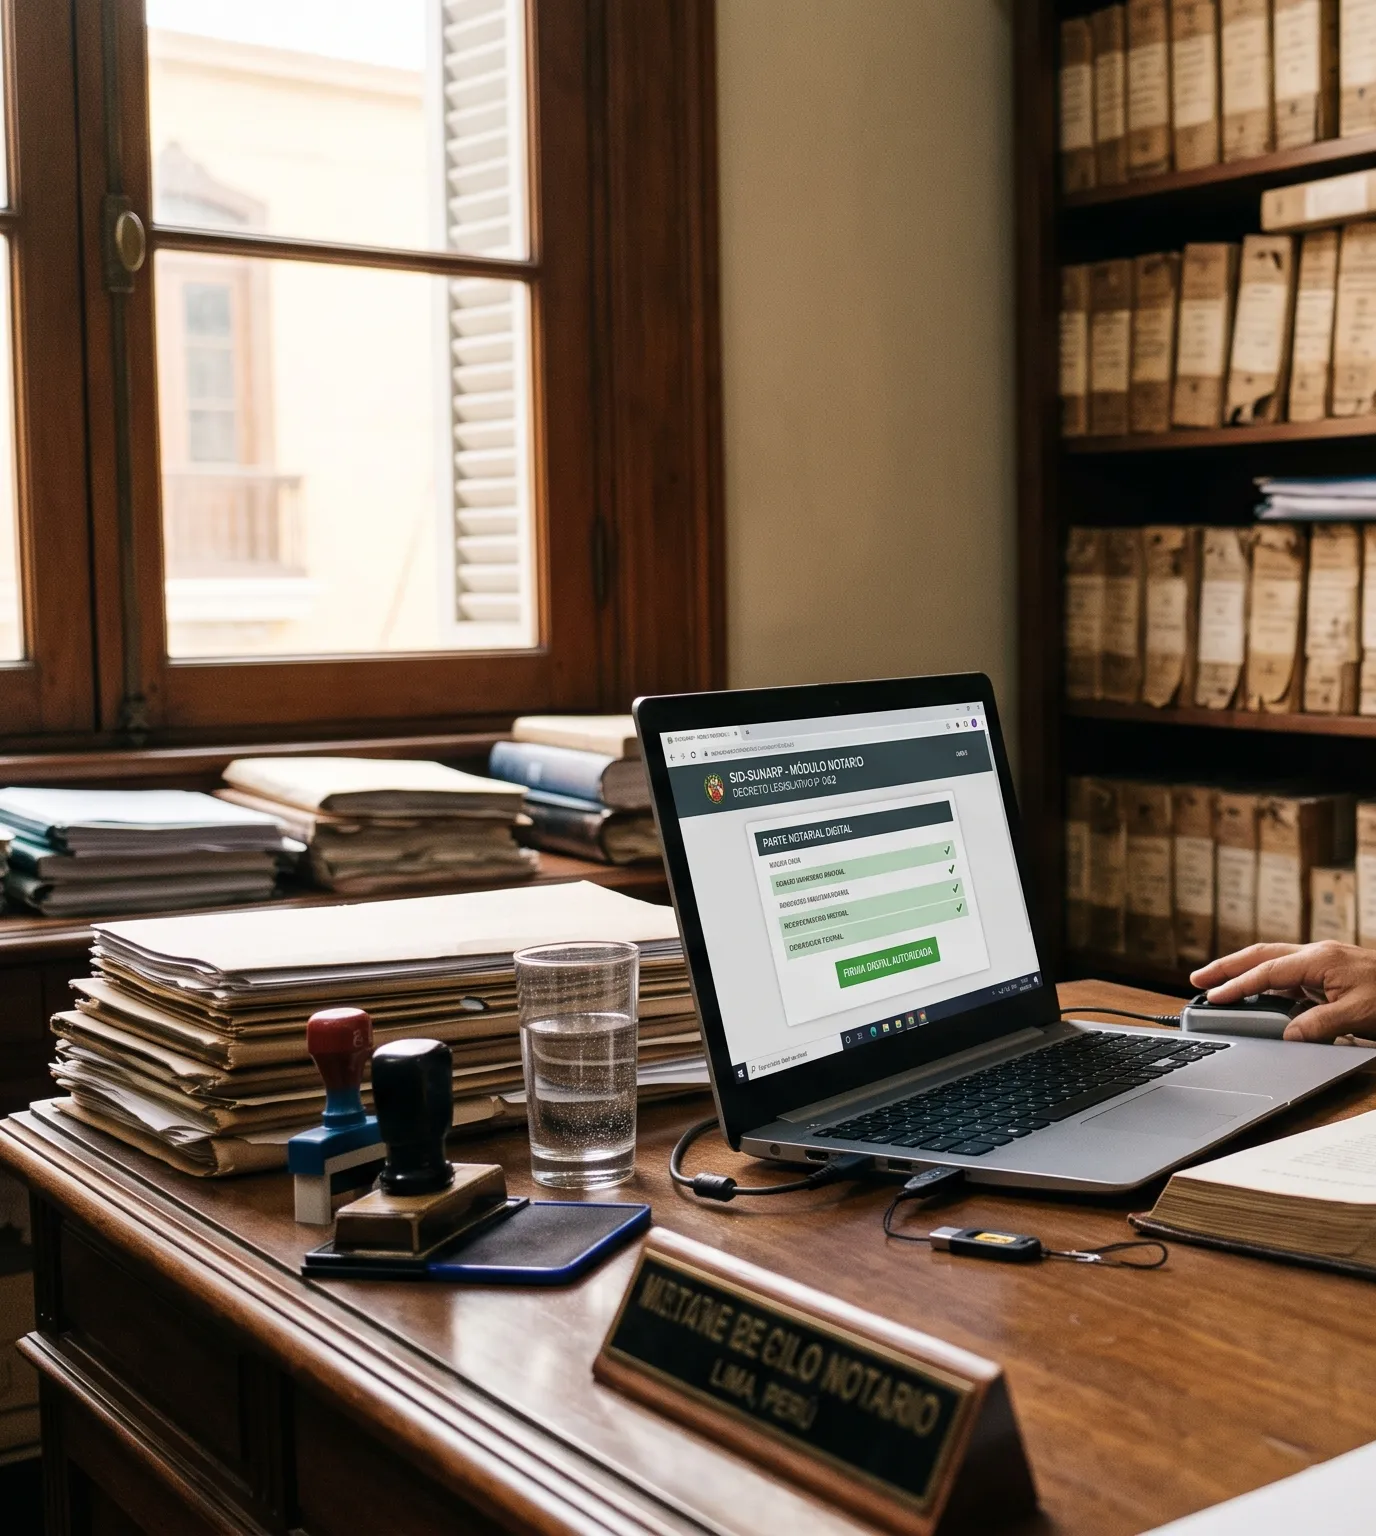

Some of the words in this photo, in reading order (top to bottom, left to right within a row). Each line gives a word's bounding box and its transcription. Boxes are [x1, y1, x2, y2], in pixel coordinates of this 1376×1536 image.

[729, 765, 783, 784] SID-SUNARP
[790, 761, 827, 776] MÓDULO
[733, 784, 769, 798] DECRETO
[762, 834, 788, 848] PARTE
[788, 828, 825, 844] NOTARIAL
[825, 824, 852, 837] DIGITAL
